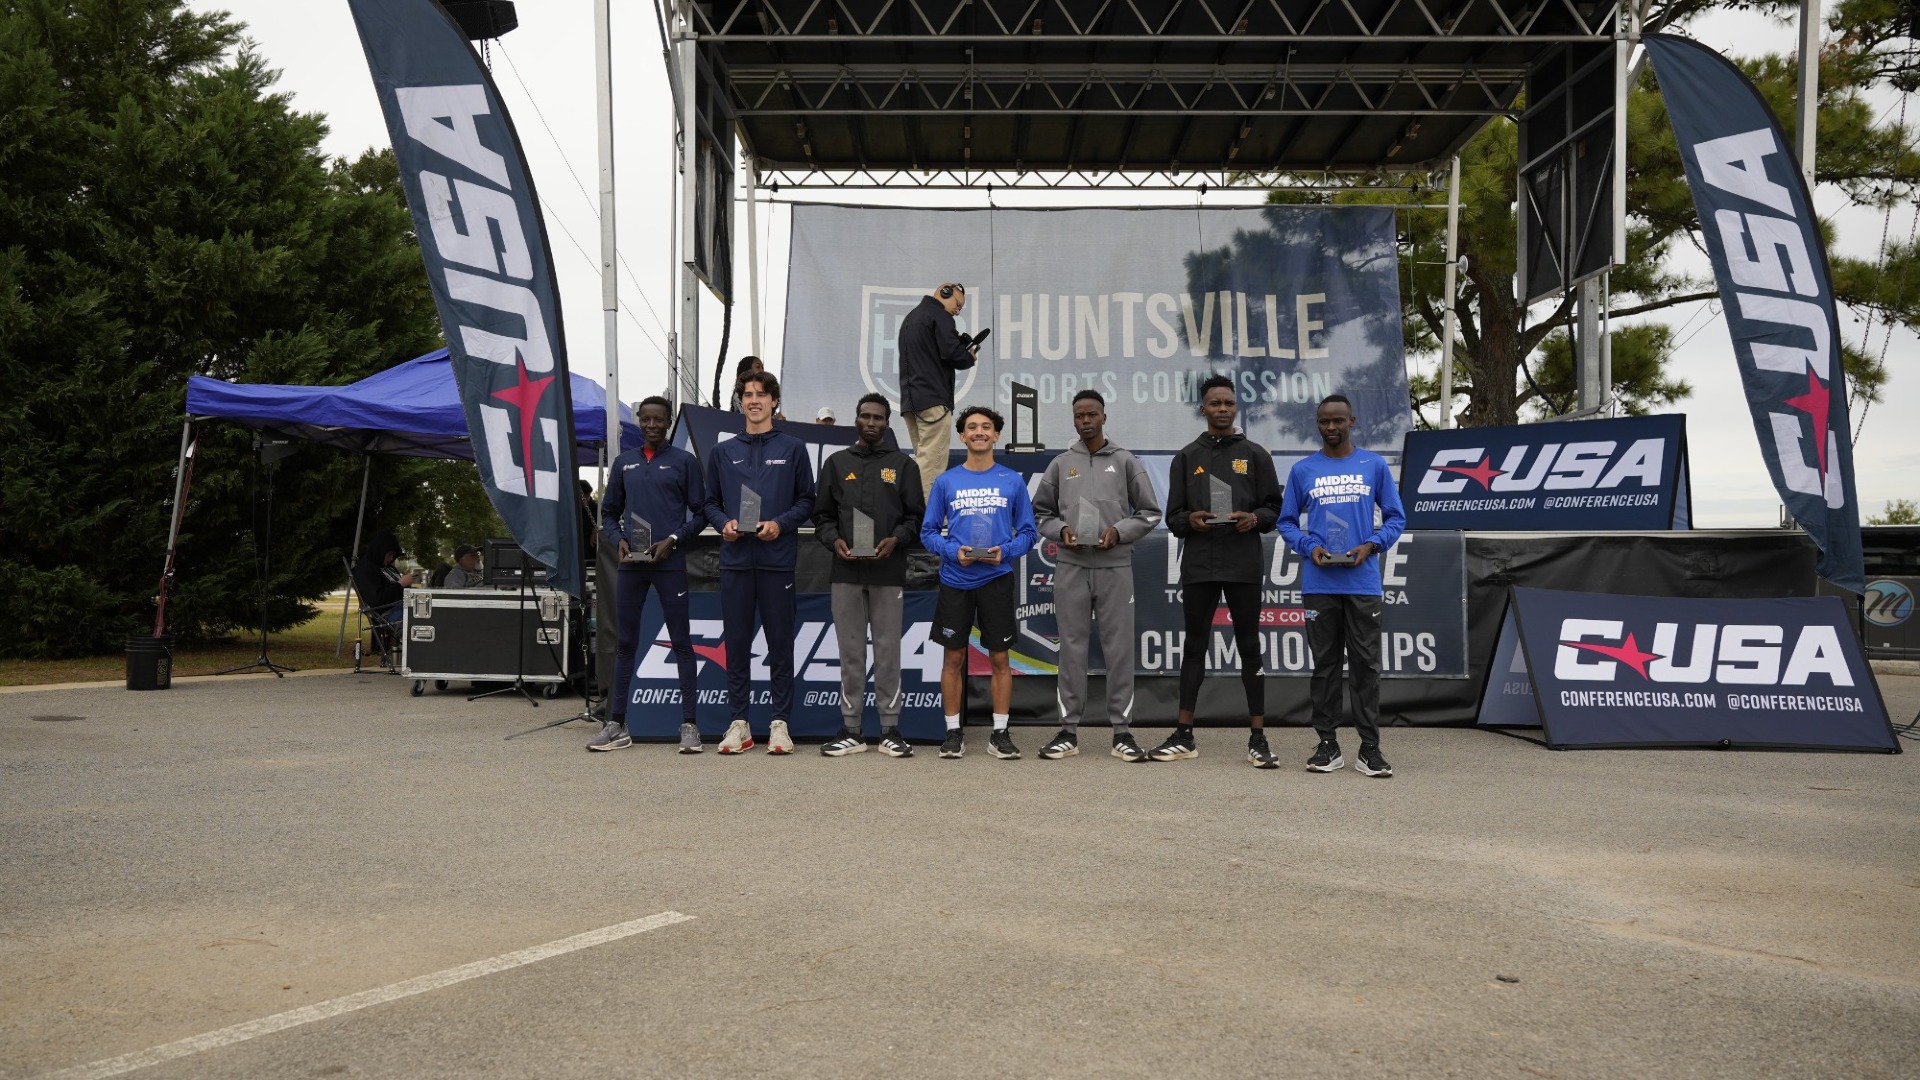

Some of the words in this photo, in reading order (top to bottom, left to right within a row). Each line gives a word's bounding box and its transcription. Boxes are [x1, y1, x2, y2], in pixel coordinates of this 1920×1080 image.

[999, 290, 1329, 360] HUNTSVILLE
[1315, 474, 1363, 487] MIDDLE
[956, 487, 1000, 499] MIDDLE
[1309, 484, 1371, 499] TENNESSEE
[950, 497, 1008, 511] TENNESSEE
[1320, 495, 1336, 505] CROSS
[1337, 495, 1360, 504] COUNTRY
[1415, 497, 1536, 512] CONFERENCEUSA.COM
[1543, 493, 1659, 509] @CONFERENCEUSA
[1560, 690, 1717, 708] CONFERENCEUSA.COM
[1727, 693, 1864, 712] @CONFERENCEUSA
